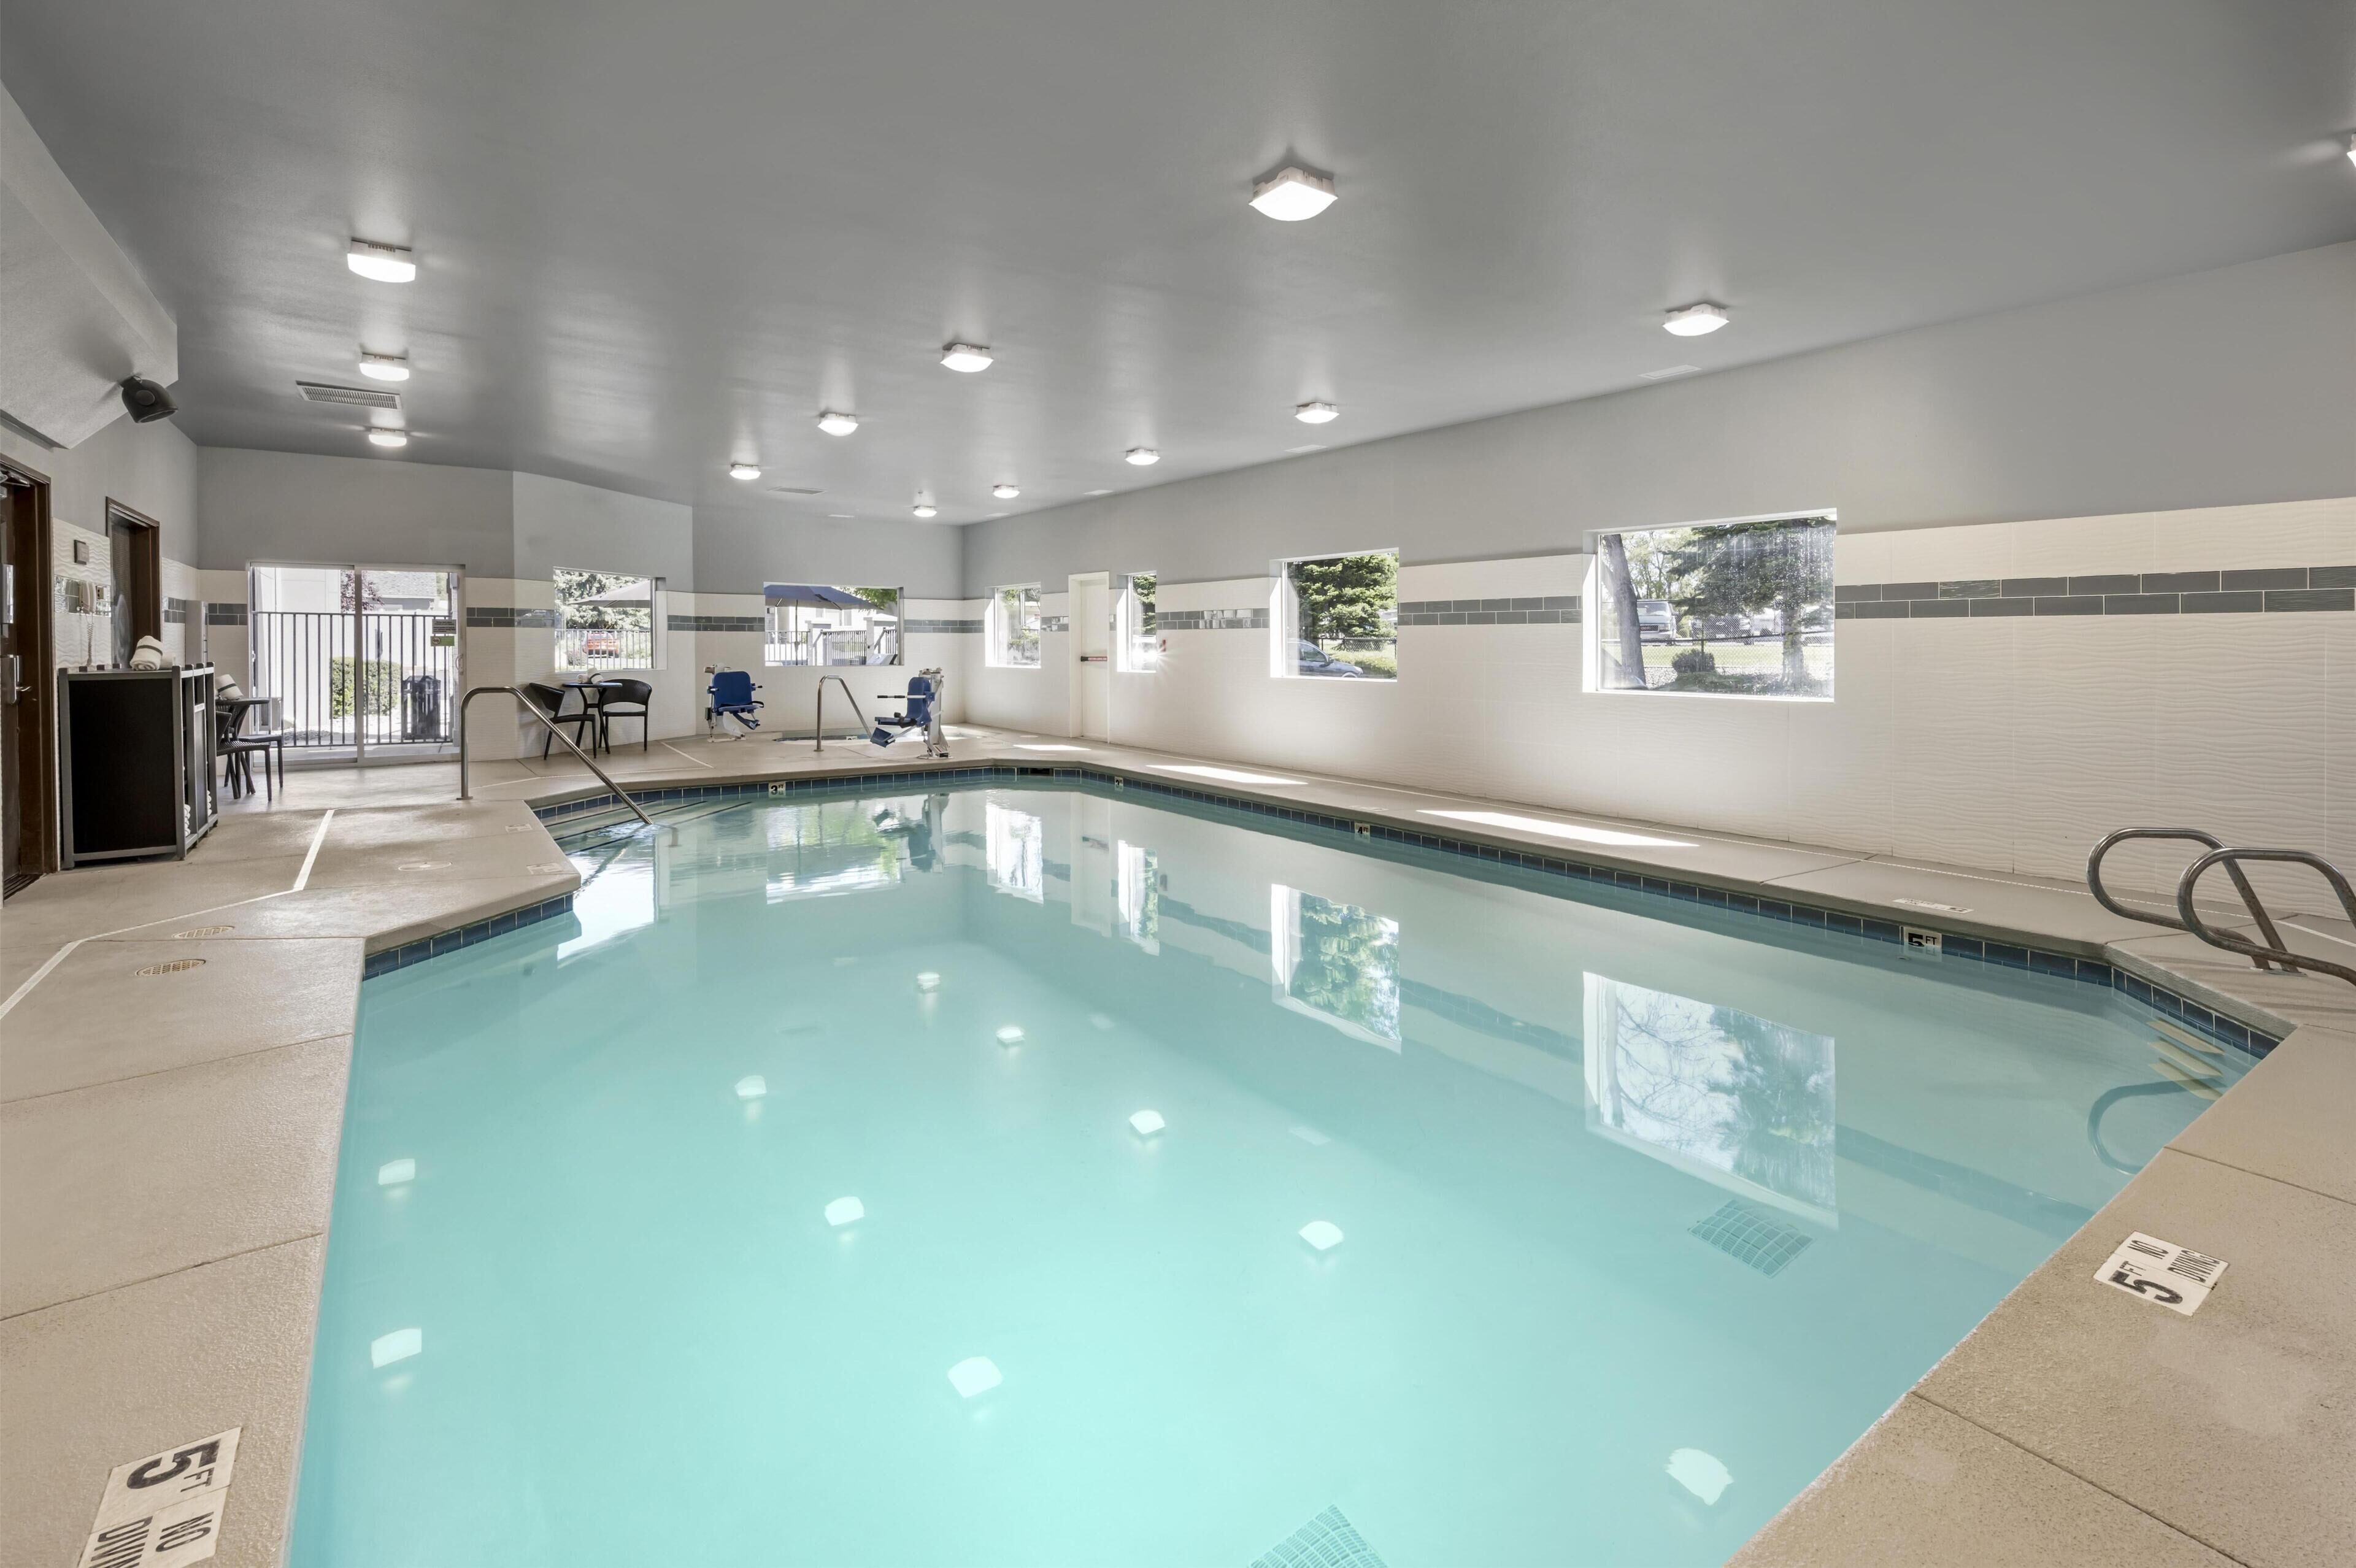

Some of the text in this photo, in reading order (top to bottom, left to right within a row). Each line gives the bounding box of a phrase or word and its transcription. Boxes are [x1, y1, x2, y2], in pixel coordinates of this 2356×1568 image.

[1908, 932, 1938, 947] 5 FT
[2127, 1240, 2169, 1259] NO
[2167, 1250, 2220, 1283] DIVING
[2108, 1261, 2183, 1304] 5 FT
[126, 1439, 221, 1493] 5 FT
[156, 1511, 214, 1553] NO
